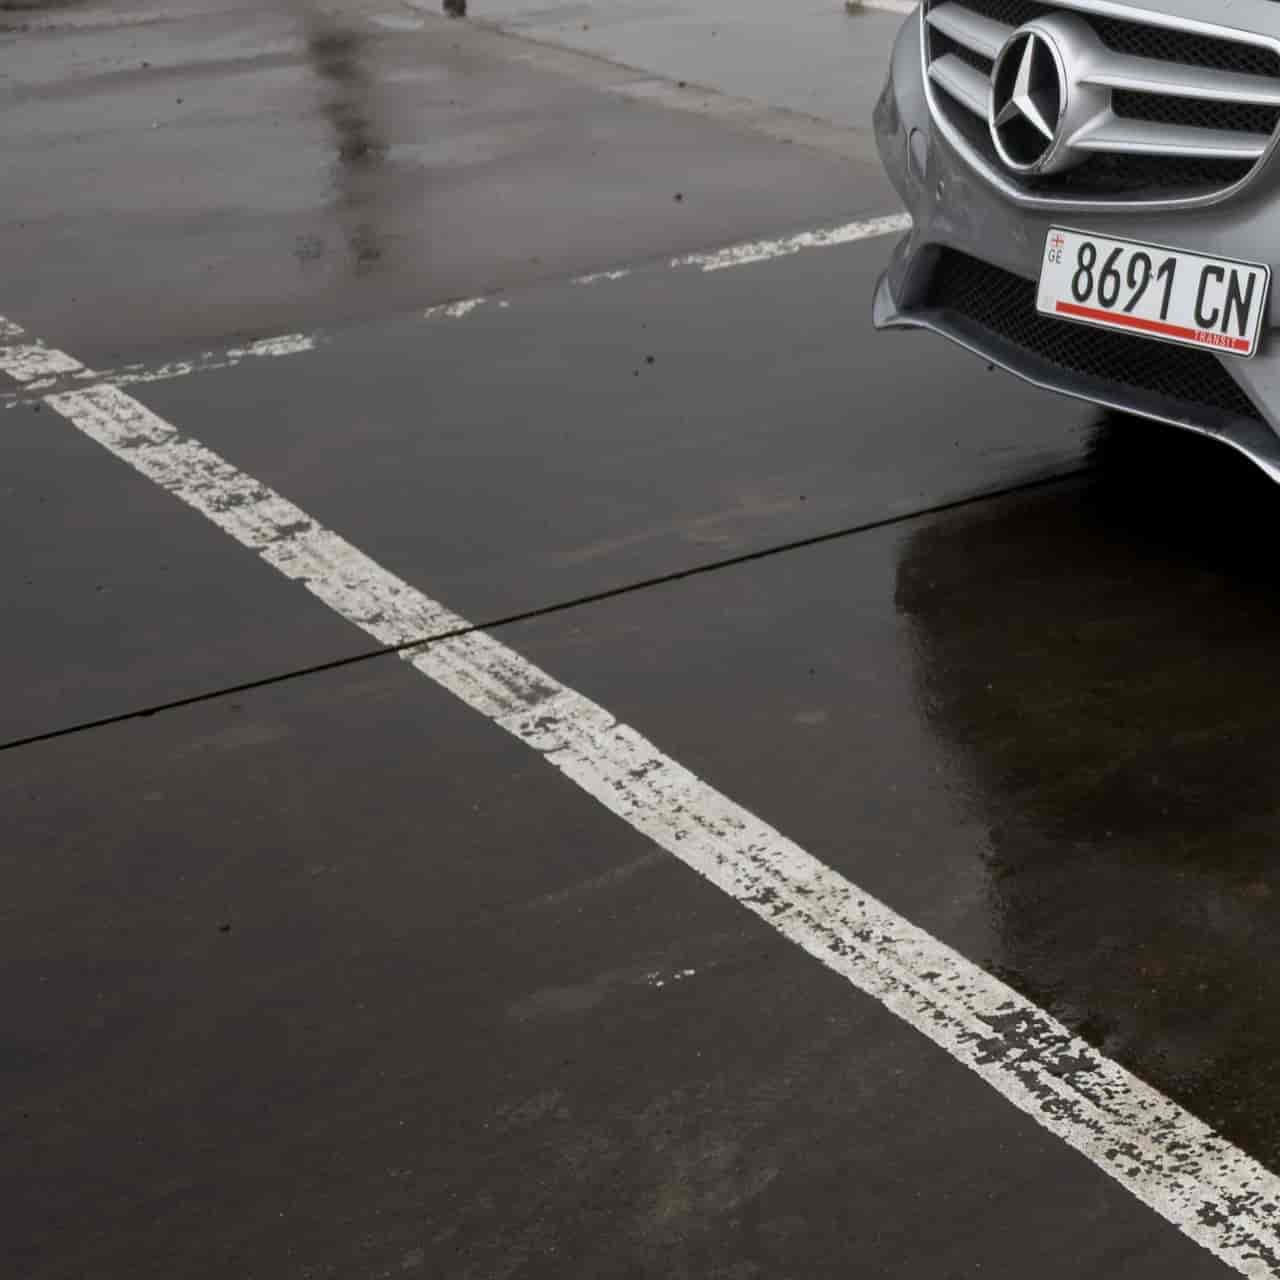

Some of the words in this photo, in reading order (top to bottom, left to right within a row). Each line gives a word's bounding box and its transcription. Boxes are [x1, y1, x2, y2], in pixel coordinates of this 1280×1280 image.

[1047, 248, 1062, 264] GE
[1071, 241, 1177, 321] 8691
[1194, 264, 1257, 336] CN
[1193, 329, 1237, 348] TRANSIT
